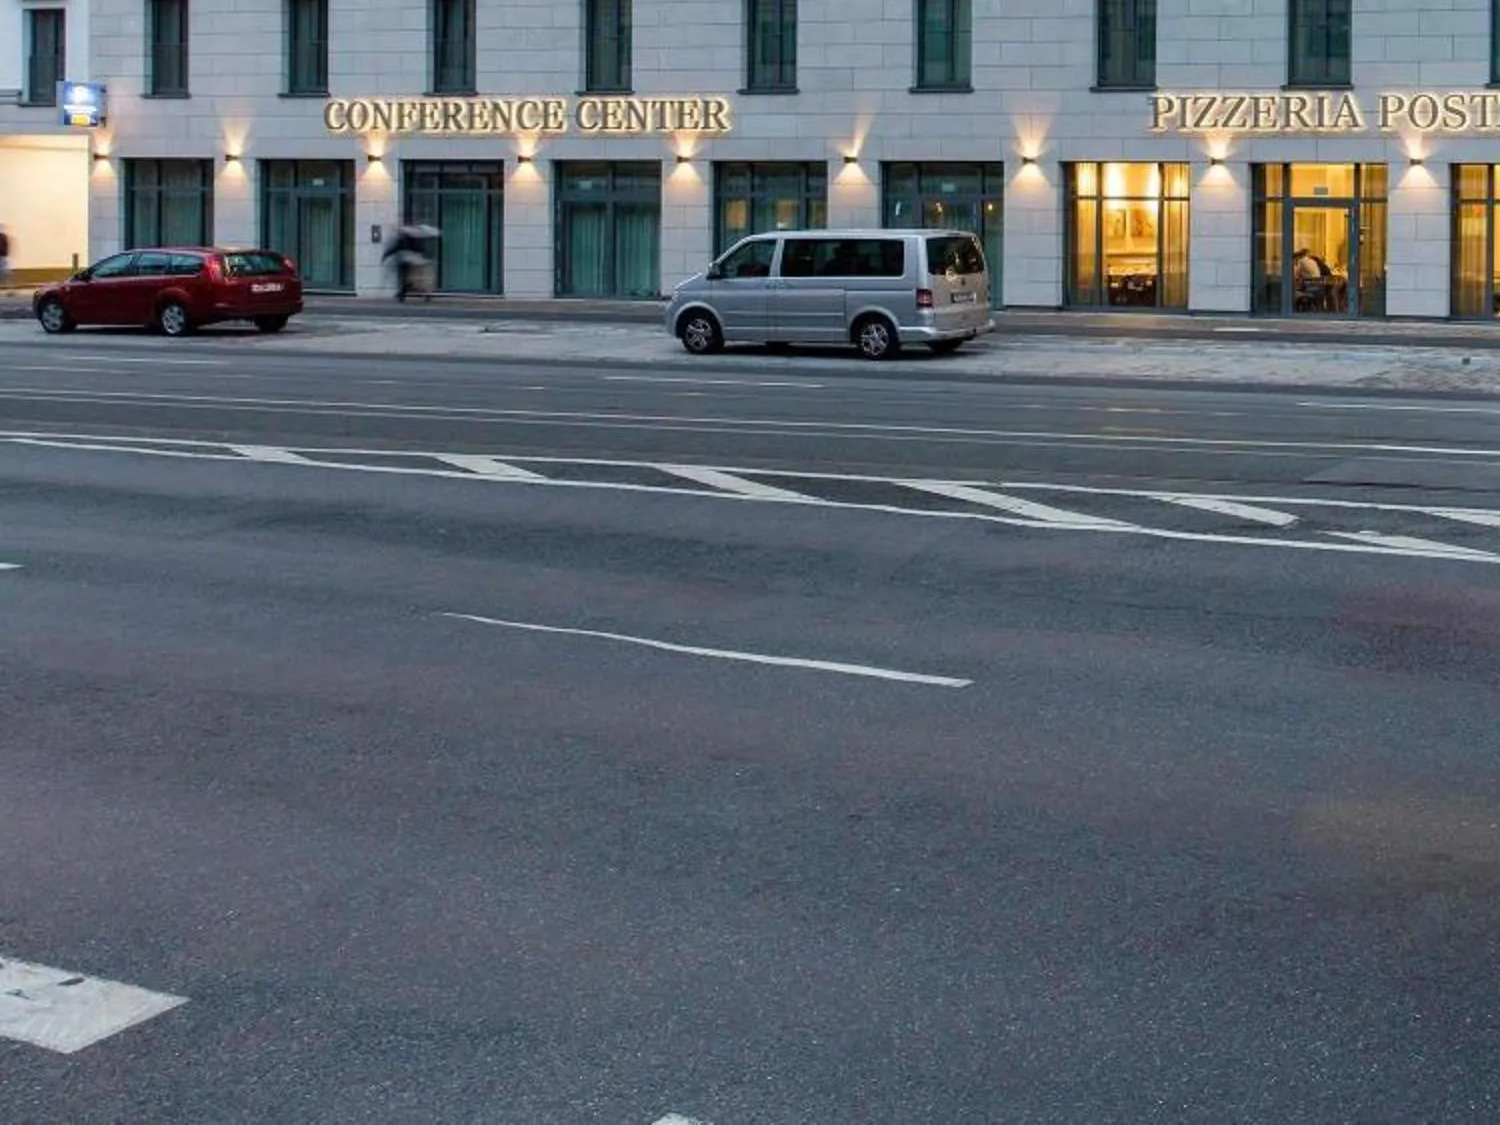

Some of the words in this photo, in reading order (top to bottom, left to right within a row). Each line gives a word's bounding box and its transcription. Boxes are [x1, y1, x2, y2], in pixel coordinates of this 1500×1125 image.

[323, 100, 565, 131] CONFERENCE
[575, 99, 729, 130] CENTER
[1151, 94, 1363, 130] PIZZERIA
